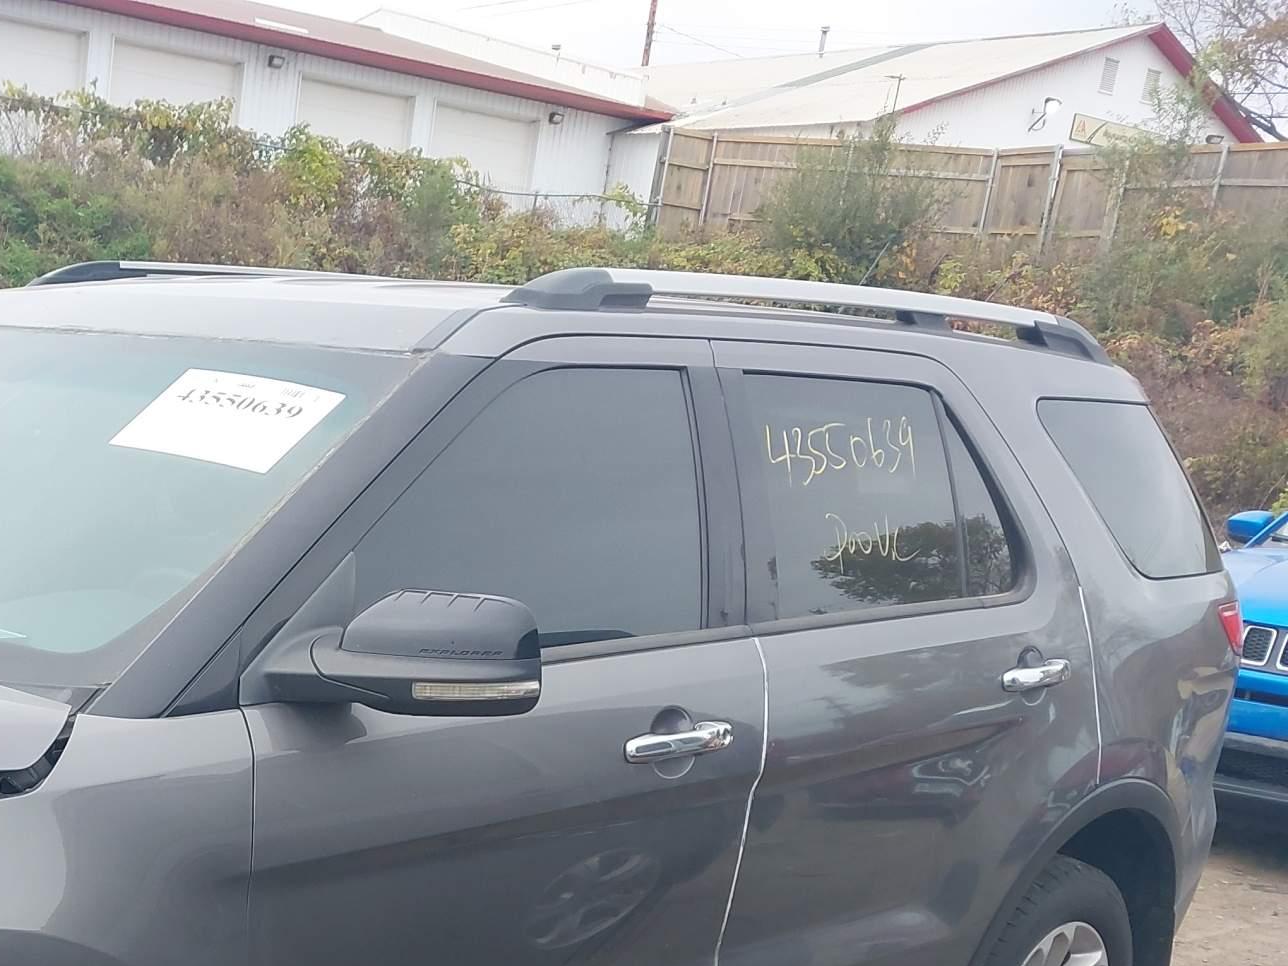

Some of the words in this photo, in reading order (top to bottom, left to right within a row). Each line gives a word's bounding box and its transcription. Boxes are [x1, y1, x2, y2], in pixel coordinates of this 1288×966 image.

[176, 388, 304, 419] 43550639
[765, 415, 917, 487] 43550639
[418, 647, 505, 657] EXPLORER
